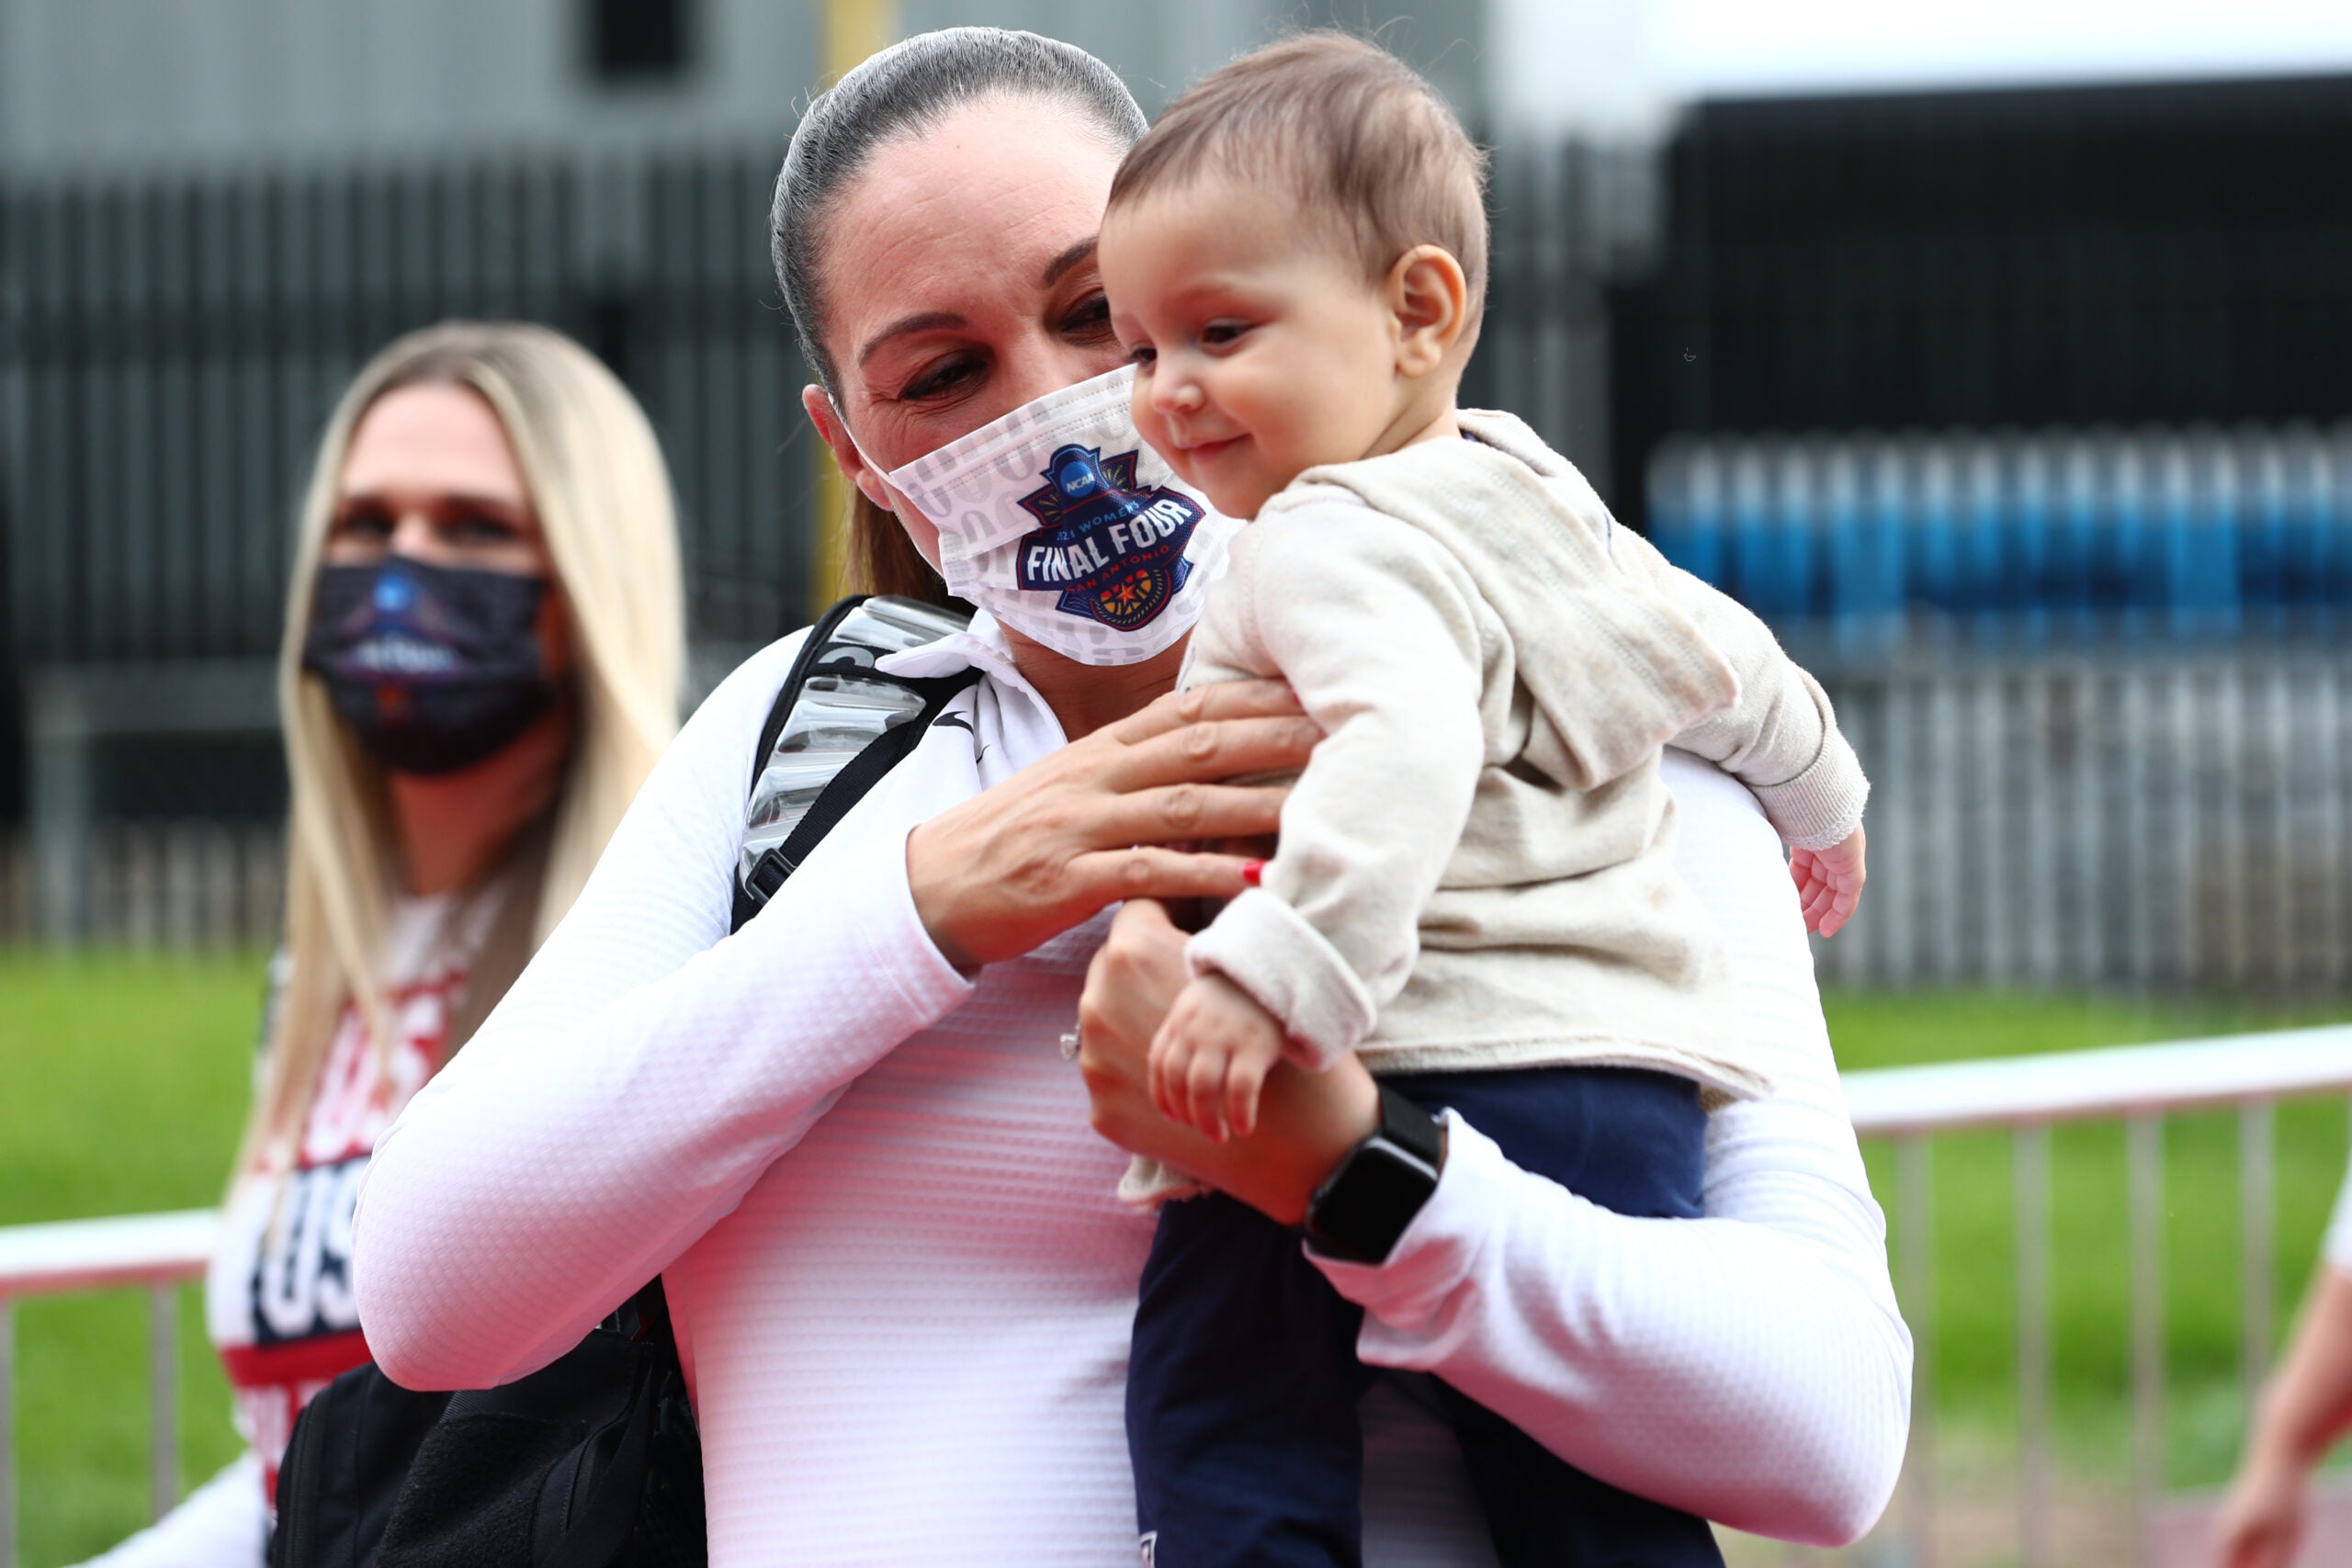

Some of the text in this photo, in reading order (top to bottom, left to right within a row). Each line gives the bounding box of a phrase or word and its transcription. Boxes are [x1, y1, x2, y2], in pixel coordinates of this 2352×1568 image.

[1066, 473, 1094, 493] NCAA
[1079, 501, 1140, 534] WOMEN'S
[1027, 499, 1193, 581] FINAL FOUR
[1066, 545, 1170, 593] SAN ANTONIO
